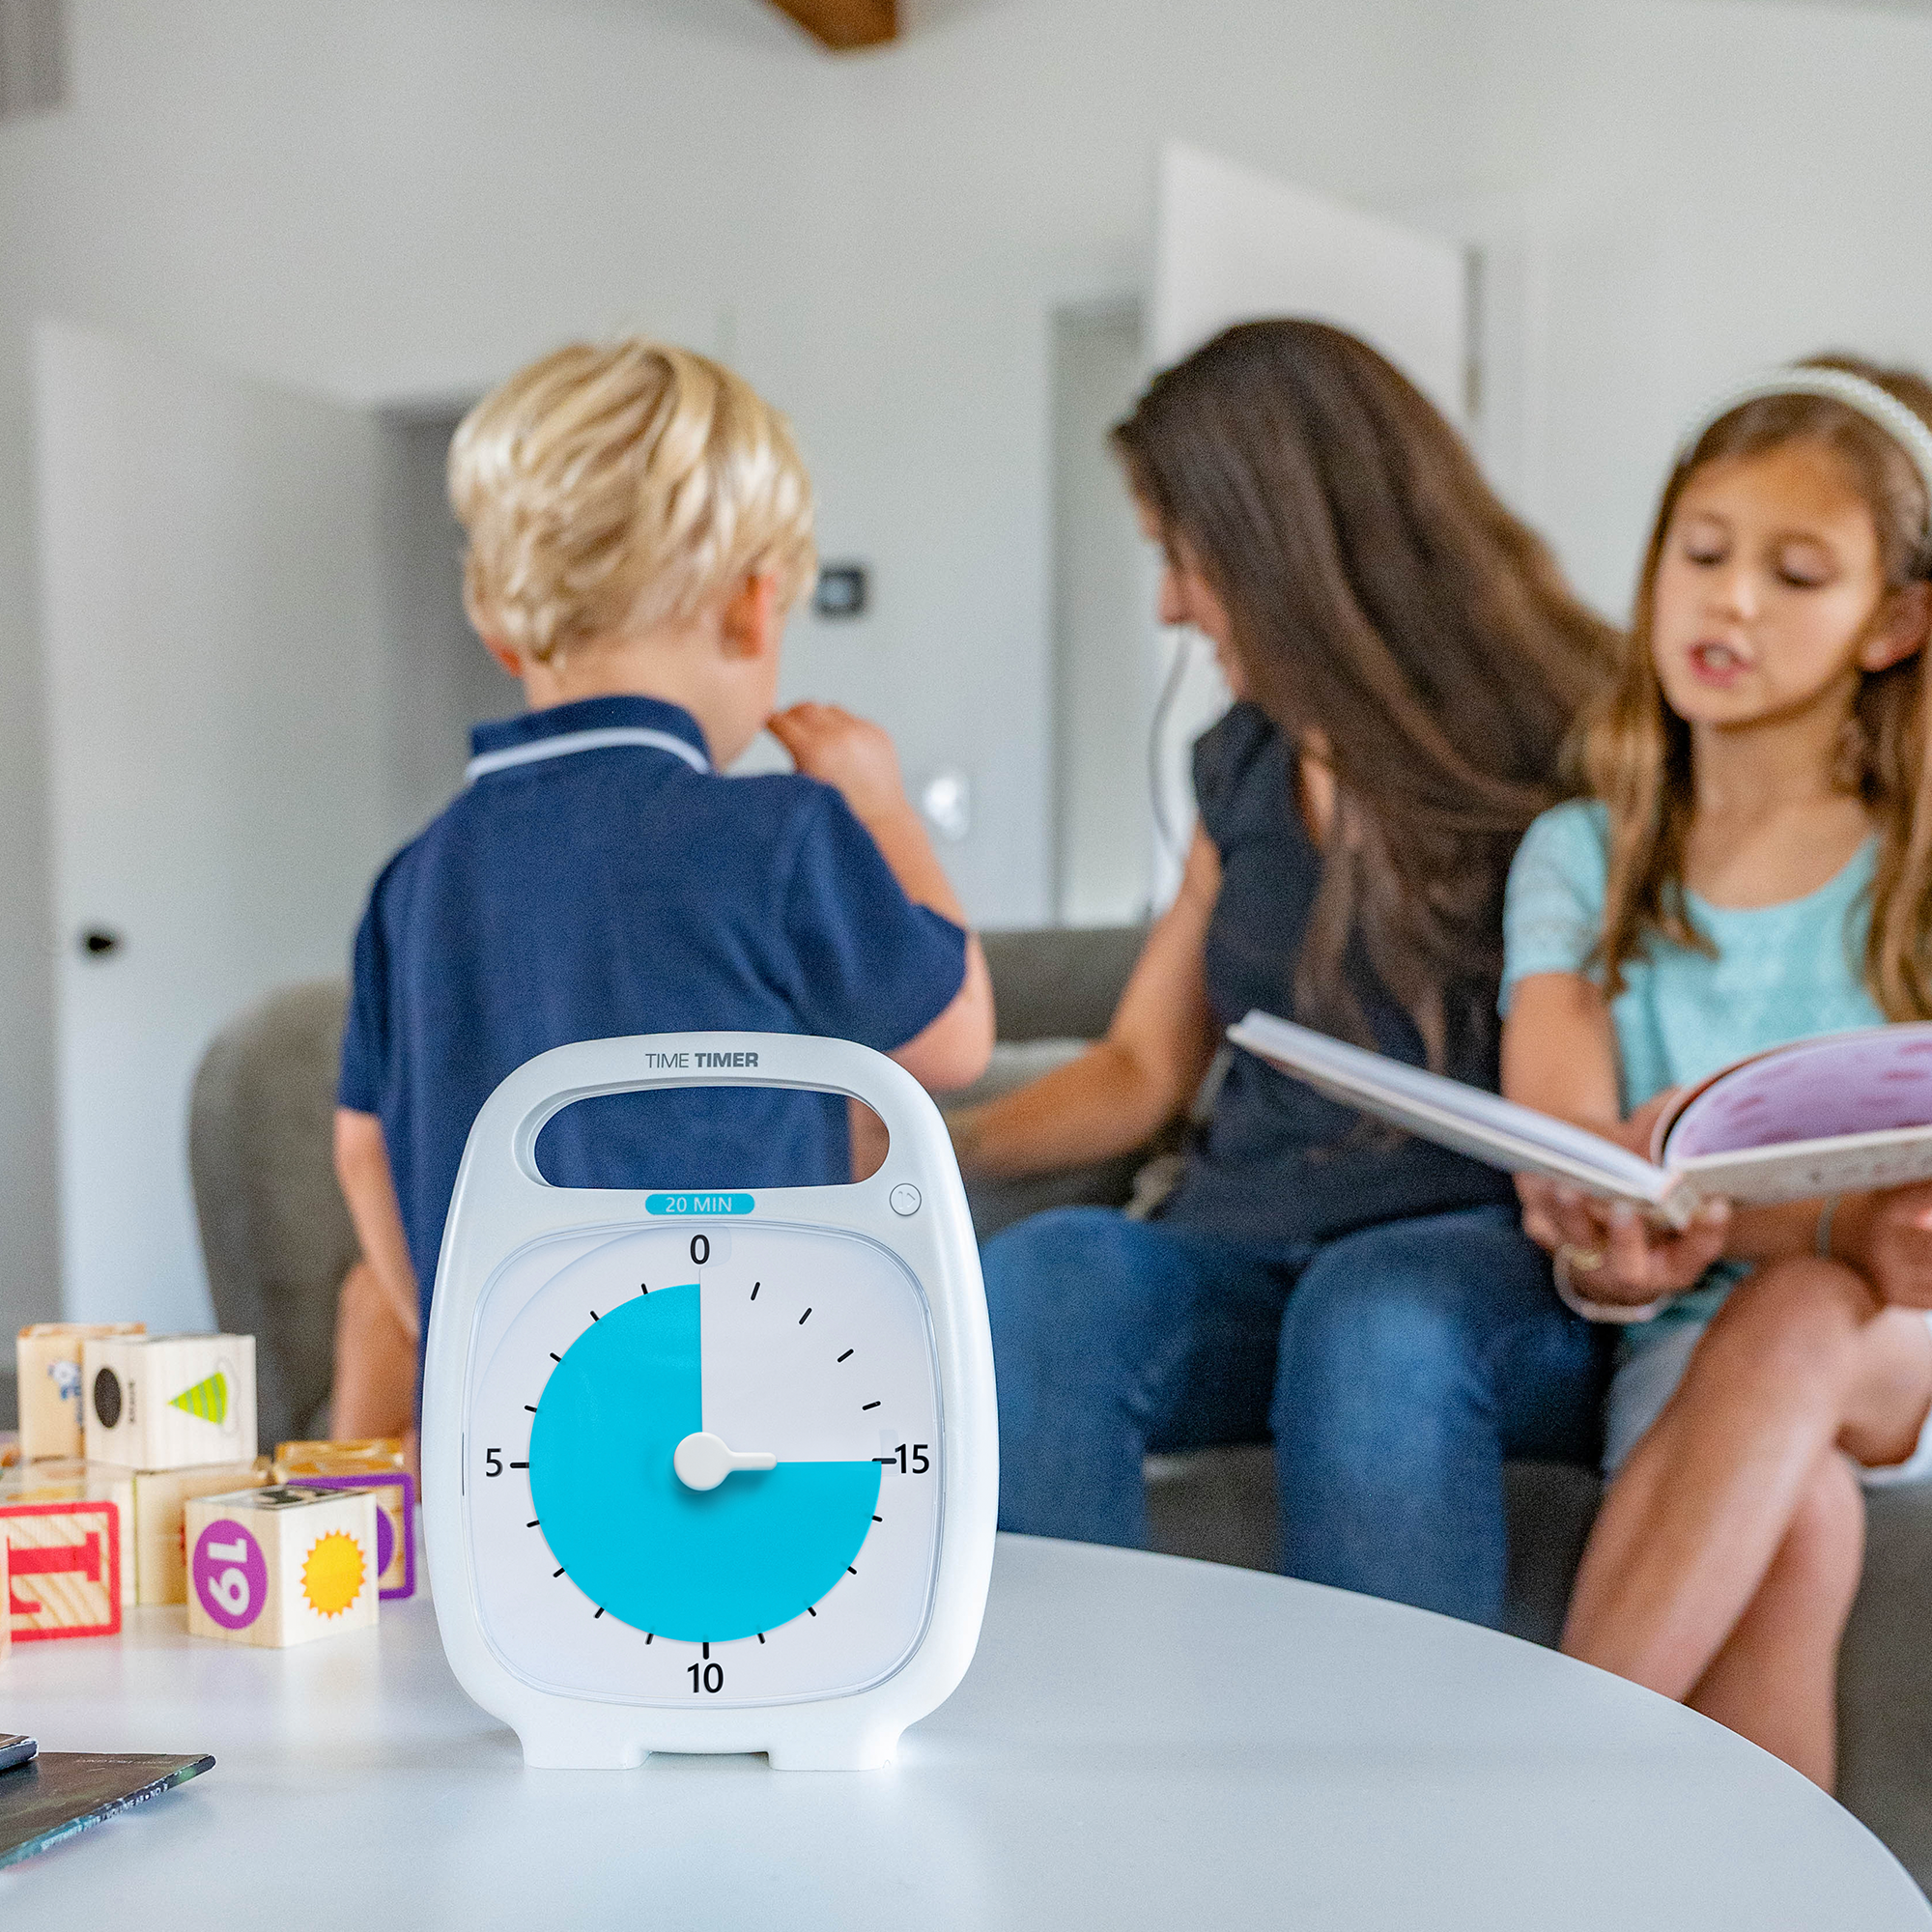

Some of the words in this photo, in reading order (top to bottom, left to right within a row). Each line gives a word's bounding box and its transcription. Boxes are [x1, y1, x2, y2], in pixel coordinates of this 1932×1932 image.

[645, 1053, 689, 1068] TIME
[695, 1052, 759, 1067] TIMER
[666, 1197, 687, 1212] 20
[694, 1197, 732, 1212] MIN
[690, 1235, 710, 1264] 0
[486, 1448, 503, 1478] 5
[895, 1443, 930, 1474] 15
[208, 1538, 250, 1616] 19
[687, 1662, 724, 1693] 10
